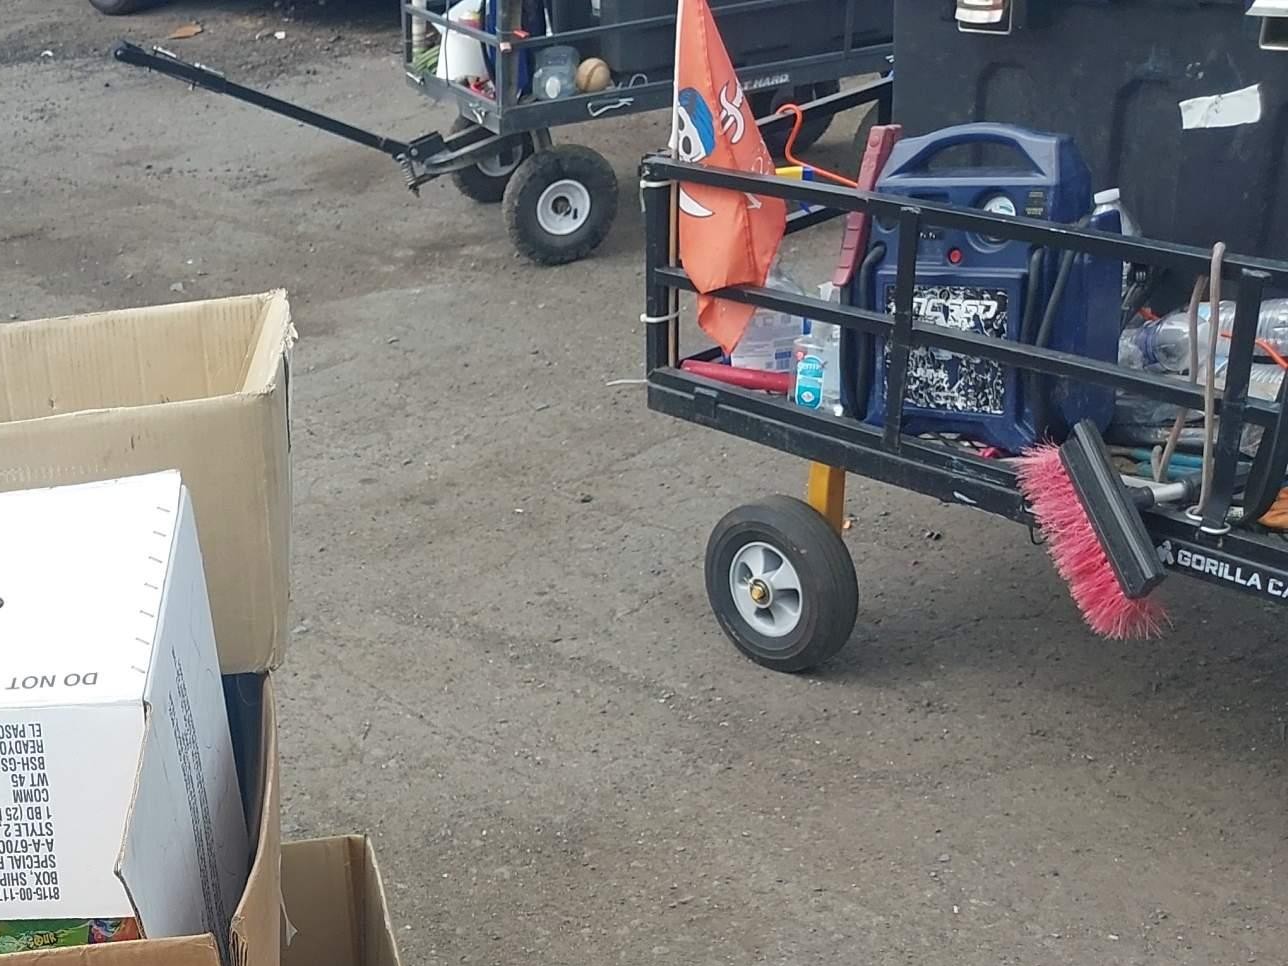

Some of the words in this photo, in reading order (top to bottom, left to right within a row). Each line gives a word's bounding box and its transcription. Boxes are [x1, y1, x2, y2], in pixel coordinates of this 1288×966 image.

[1177, 549, 1262, 590] GORILLA
[5, 675, 56, 690] NOT
[64, 672, 98, 687] DO
[28, 723, 42, 737] EL
[11, 773, 25, 787] 45
[29, 773, 49, 787] WT
[12, 788, 49, 803] COMM
[6, 804, 23, 822] (25
[26, 806, 42, 820] BD
[46, 806, 52, 820] 1
[0, 822, 12, 838] 2,
[15, 821, 54, 838] STYLE
[10, 854, 56, 869] SPECIAL
[29, 870, 58, 885] BOX,
